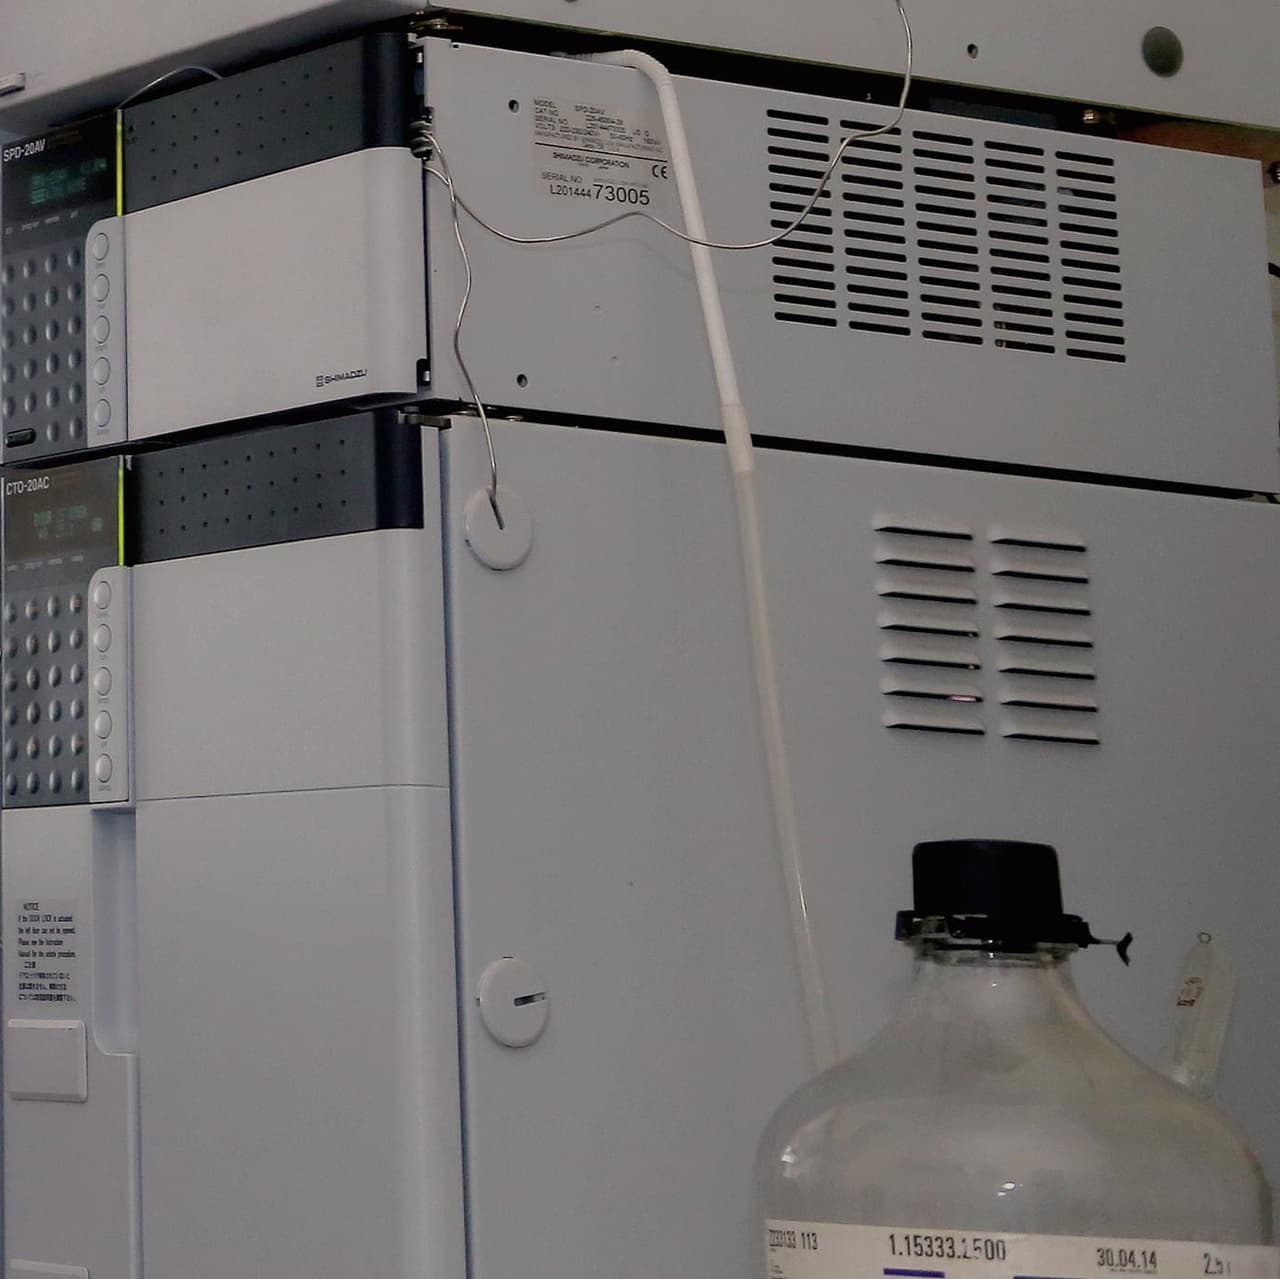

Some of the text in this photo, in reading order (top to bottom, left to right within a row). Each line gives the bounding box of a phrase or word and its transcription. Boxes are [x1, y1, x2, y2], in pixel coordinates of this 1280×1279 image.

[3, 138, 46, 162] SPD-20AV
[585, 155, 630, 168] CORPORATION
[541, 171, 568, 183] SERIAL
[550, 183, 592, 199] L201444
[593, 183, 650, 206] 73005
[325, 369, 368, 384] SHIMADZU
[6, 476, 50, 495] CTO-20AC
[800, 1231, 819, 1251] 113
[888, 1233, 1007, 1261] 1.15333.2500
[1096, 1247, 1159, 1270] 30.04.14
